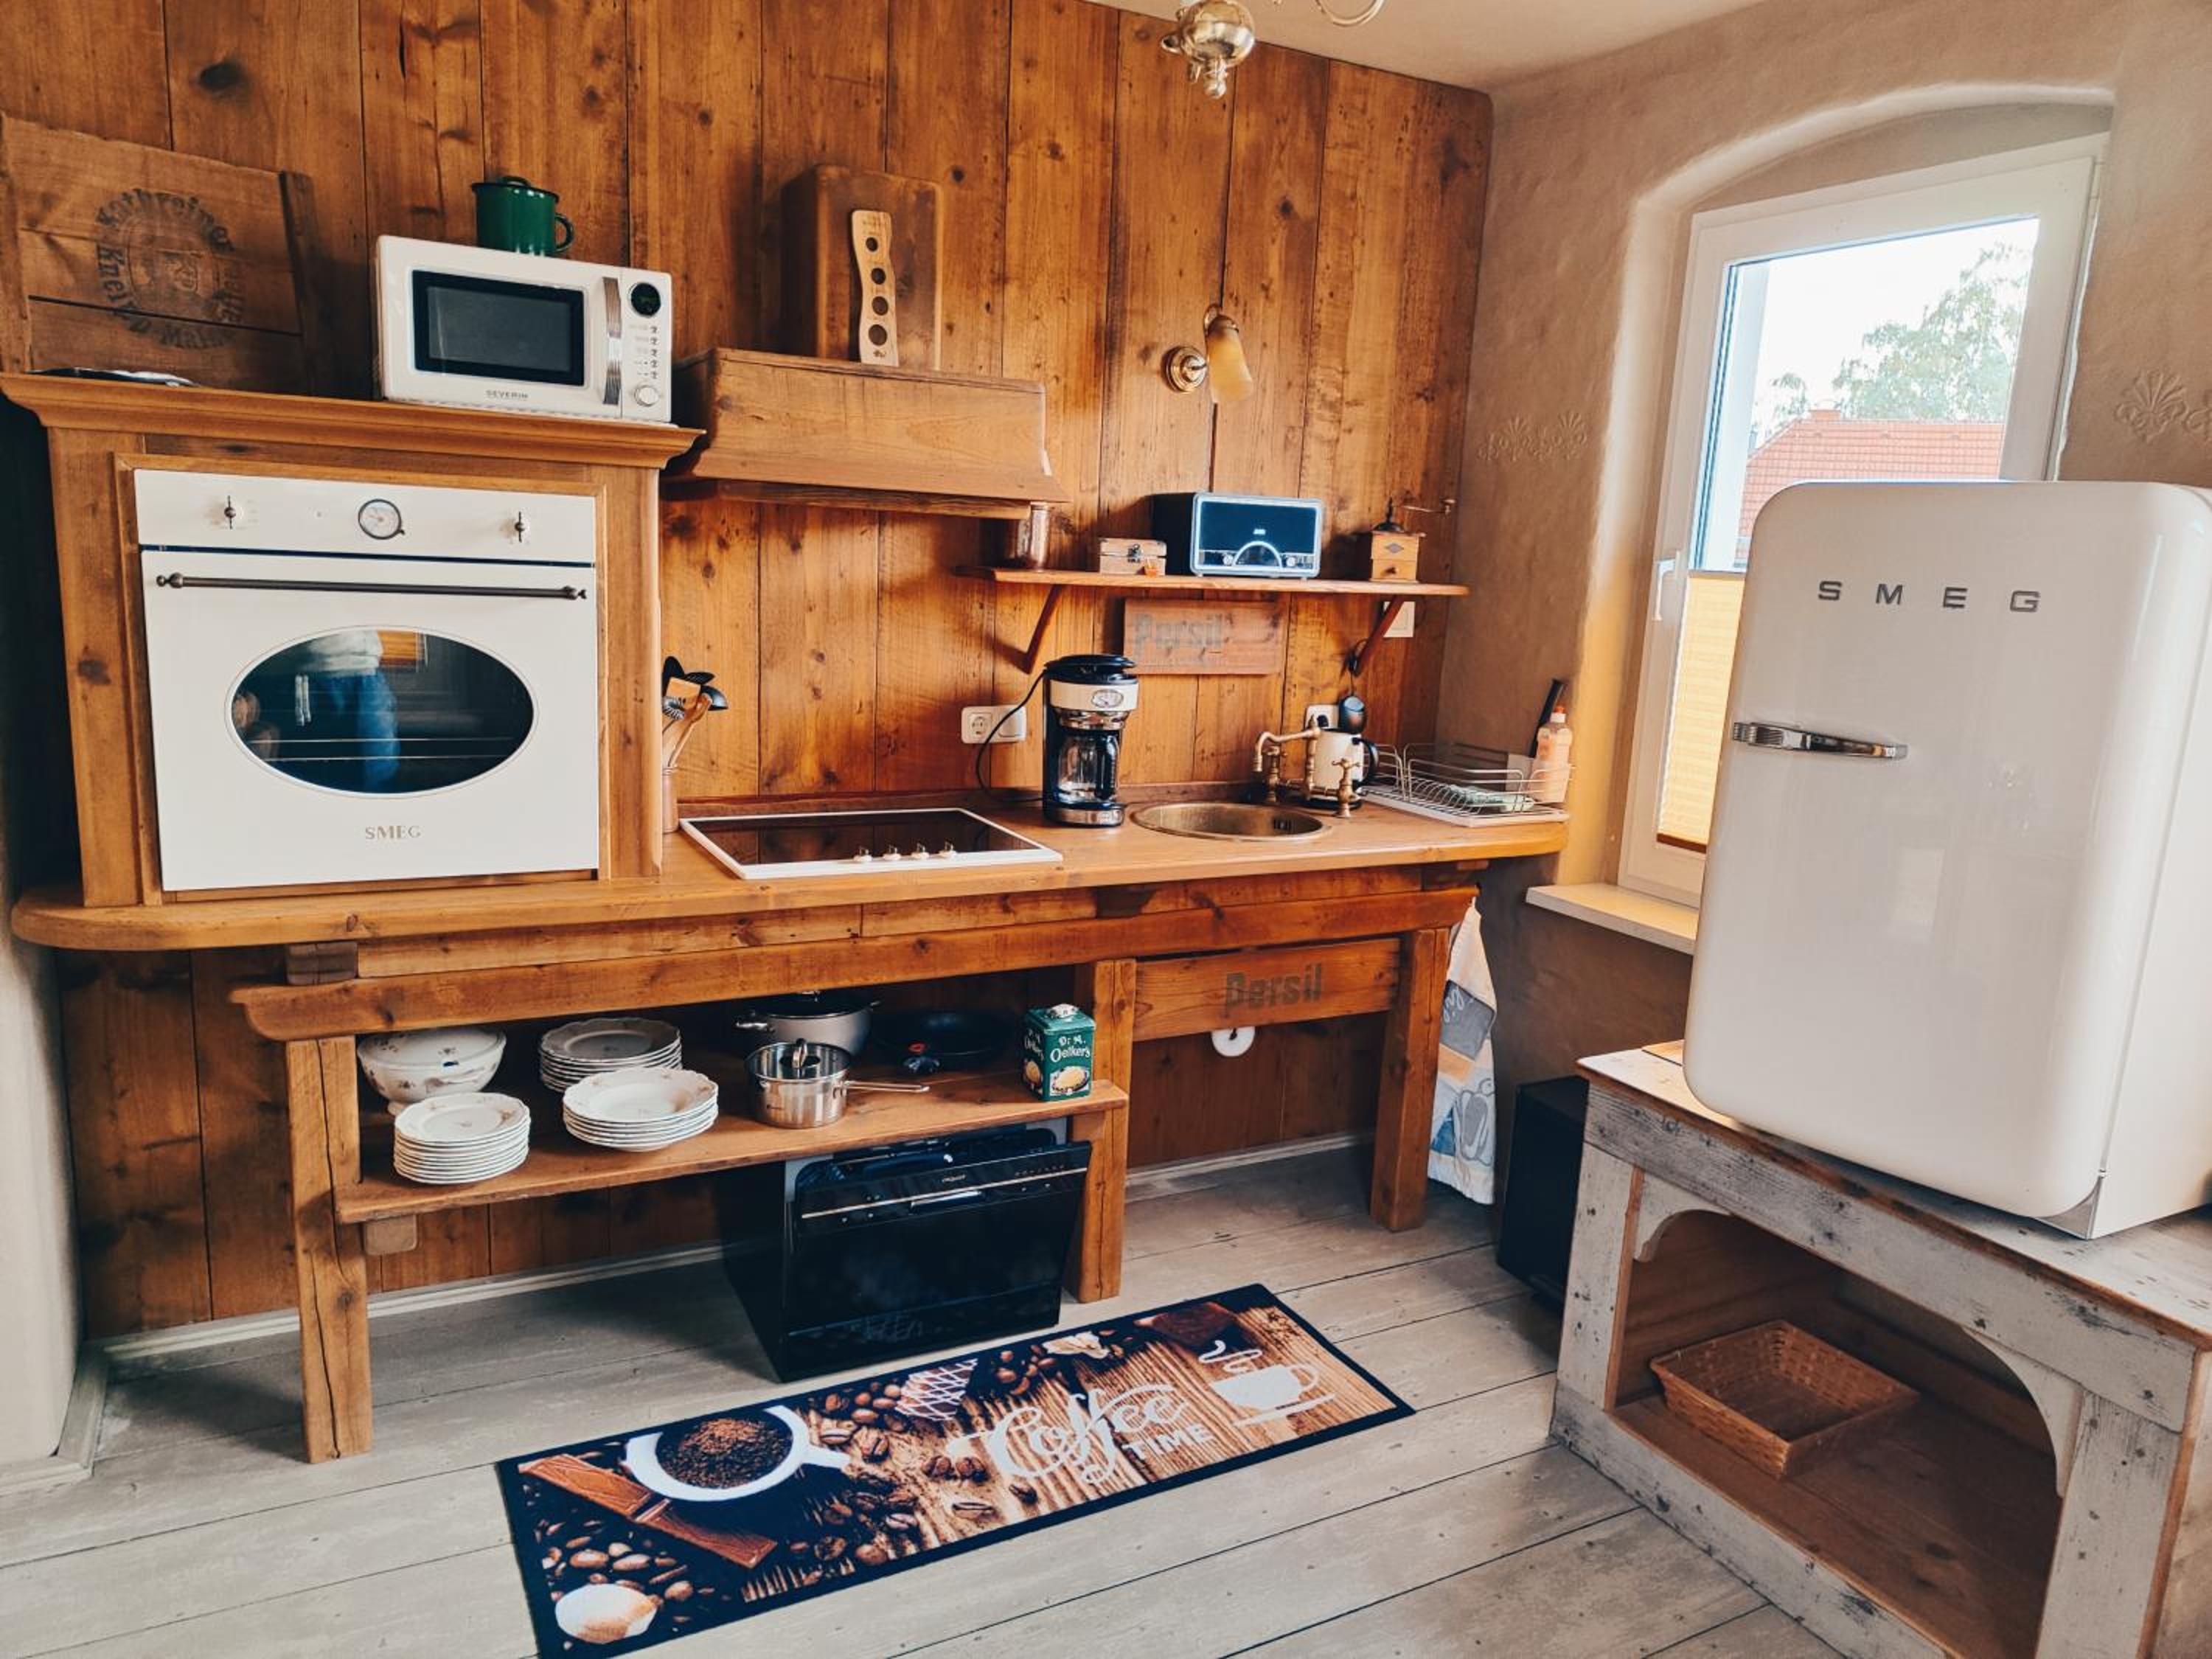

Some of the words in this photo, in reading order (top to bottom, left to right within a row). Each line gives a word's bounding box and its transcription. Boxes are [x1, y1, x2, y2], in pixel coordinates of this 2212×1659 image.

[1818, 580, 2041, 613] SMEG
[365, 825, 422, 840] SMEG
[1224, 963, 1322, 1018] Persil
[987, 1384, 1189, 1484] Coffee
[1122, 1423, 1214, 1461] TIME
